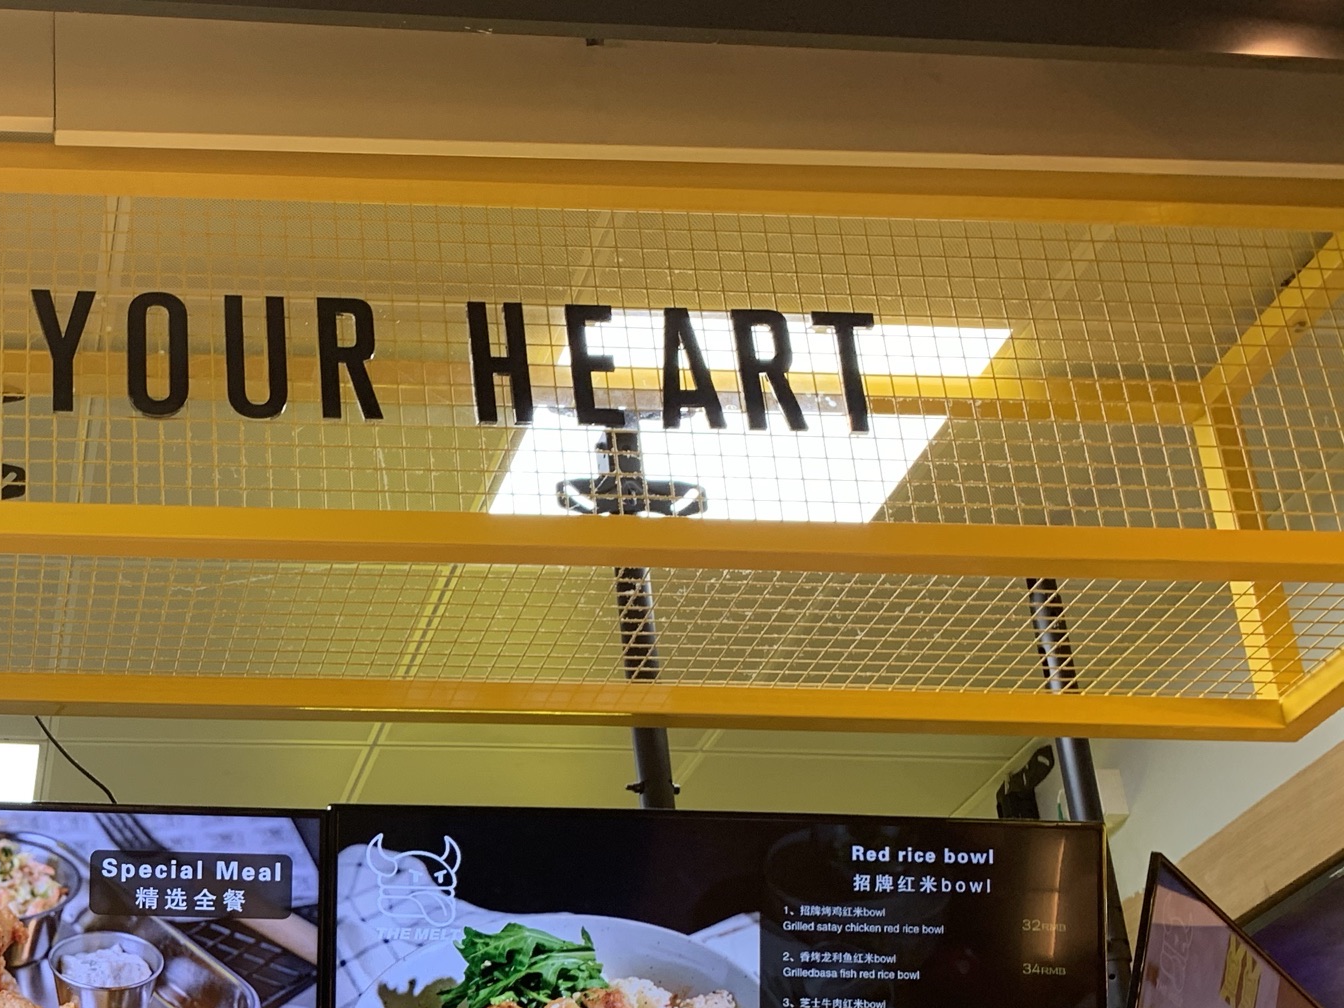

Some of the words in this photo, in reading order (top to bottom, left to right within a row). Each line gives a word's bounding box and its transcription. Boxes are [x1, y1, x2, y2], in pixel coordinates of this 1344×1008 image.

[31, 289, 383, 420] YOUR
[466, 301, 875, 433] HEART
[851, 846, 890, 863] Red
[898, 847, 936, 863] rice
[944, 848, 994, 864] bowl
[101, 858, 203, 881] Special
[216, 861, 282, 881] Meal
[853, 874, 992, 894] 招牌红米bowl
[136, 887, 246, 912] 精选全餐
[377, 928, 412, 940] THE
[414, 928, 459, 941] MELT
[783, 921, 815, 931] Grilled
[816, 923, 843, 934] satay
[845, 922, 882, 933] chicken
[883, 924, 900, 933] red
[902, 924, 920, 934] rice
[922, 925, 945, 935] bowl
[840, 968, 857, 979] fish
[859, 969, 875, 979] red
[877, 969, 895, 979] rice
[897, 970, 920, 980] bowl
[1022, 963, 1067, 976] 34RMB
